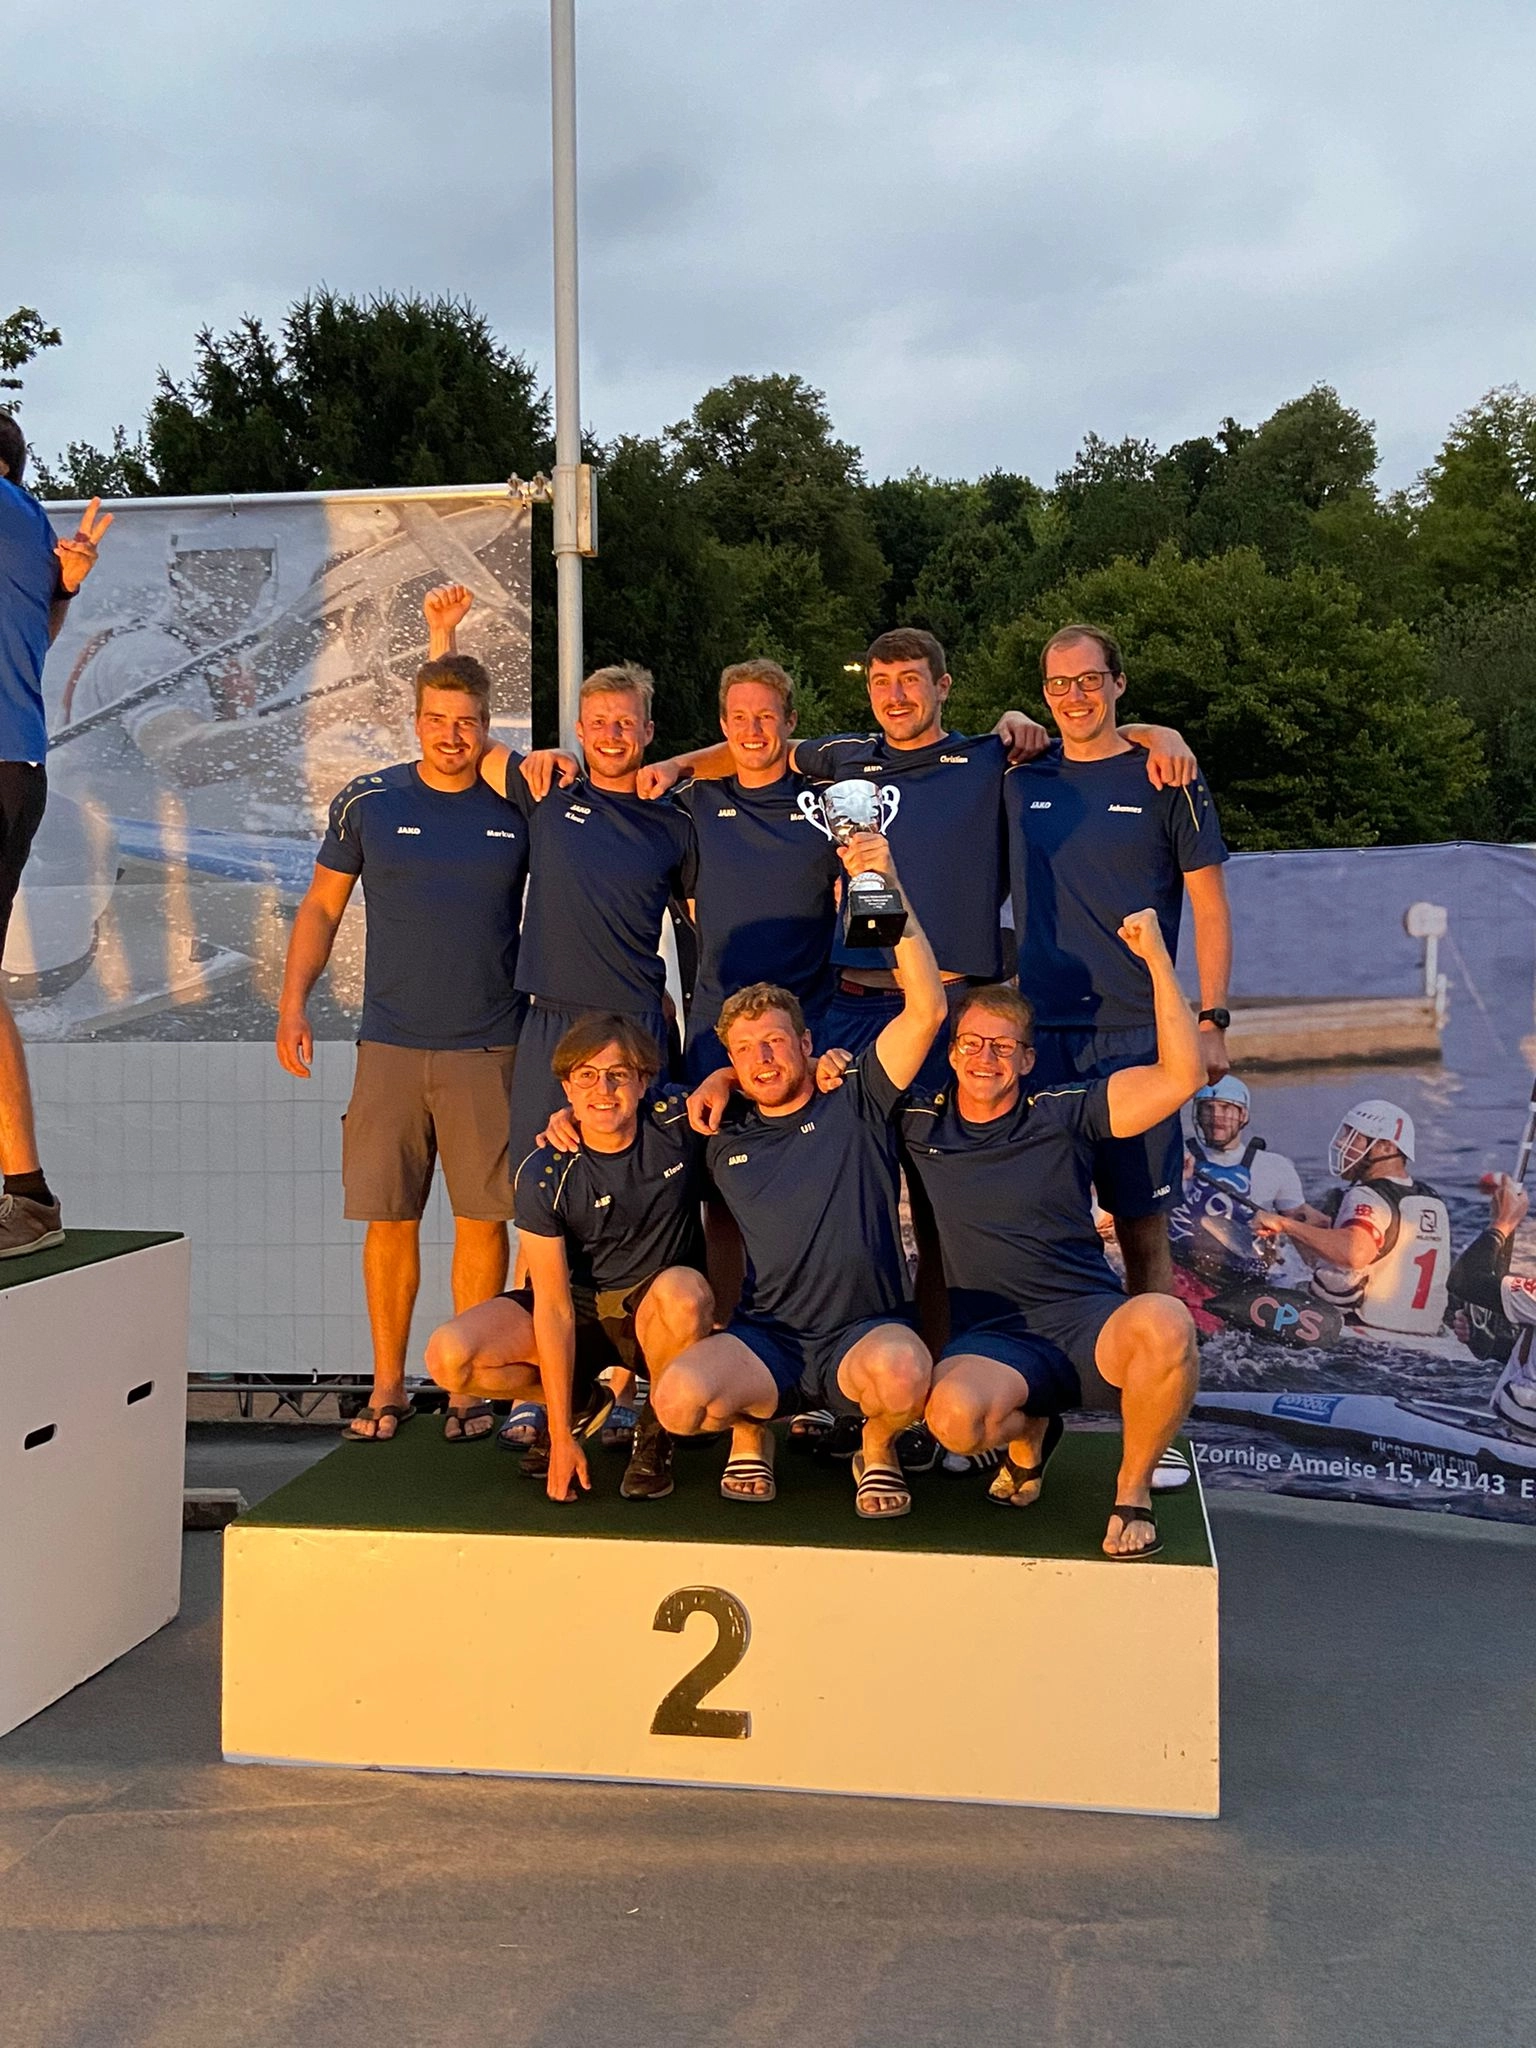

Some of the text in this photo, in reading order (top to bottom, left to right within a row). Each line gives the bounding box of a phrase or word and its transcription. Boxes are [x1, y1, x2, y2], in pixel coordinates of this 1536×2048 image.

[938, 754, 969, 764] Christian
[569, 803, 591, 815] JAKO
[1030, 801, 1052, 809] JAKO
[717, 808, 737, 817] JAKO
[397, 826, 421, 835] JAKO
[486, 829, 516, 839] Markus
[728, 1153, 748, 1166] JAKO
[1152, 1184, 1171, 1199] JAKO
[1411, 1248, 1438, 1310] 1
[1250, 1296, 1324, 1341] CPS
[1195, 1443, 1282, 1472] Zornige
[1288, 1452, 1377, 1480] Ameise
[1385, 1461, 1422, 1488] 15,
[1428, 1467, 1505, 1495] 45143
[650, 1584, 752, 1740] 2
